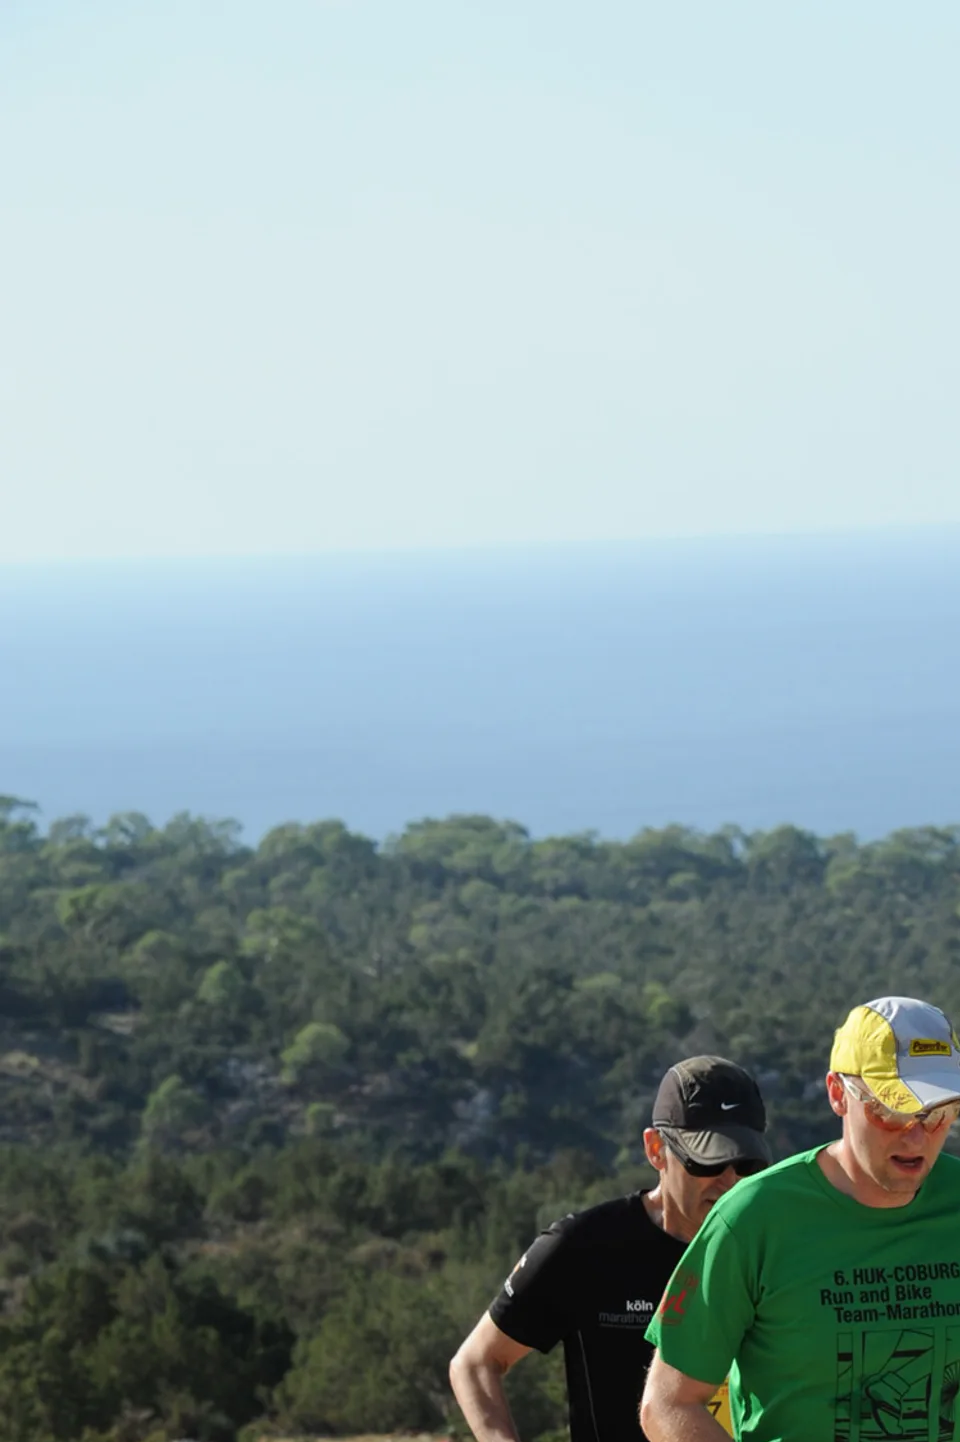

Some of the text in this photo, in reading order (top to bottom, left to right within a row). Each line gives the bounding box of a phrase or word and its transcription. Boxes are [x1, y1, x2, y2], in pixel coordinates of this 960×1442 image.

[833, 1262, 960, 1287] 6. HUK-COBURG
[626, 1300, 653, 1312] köln
[820, 1284, 932, 1306] Run and Bike
